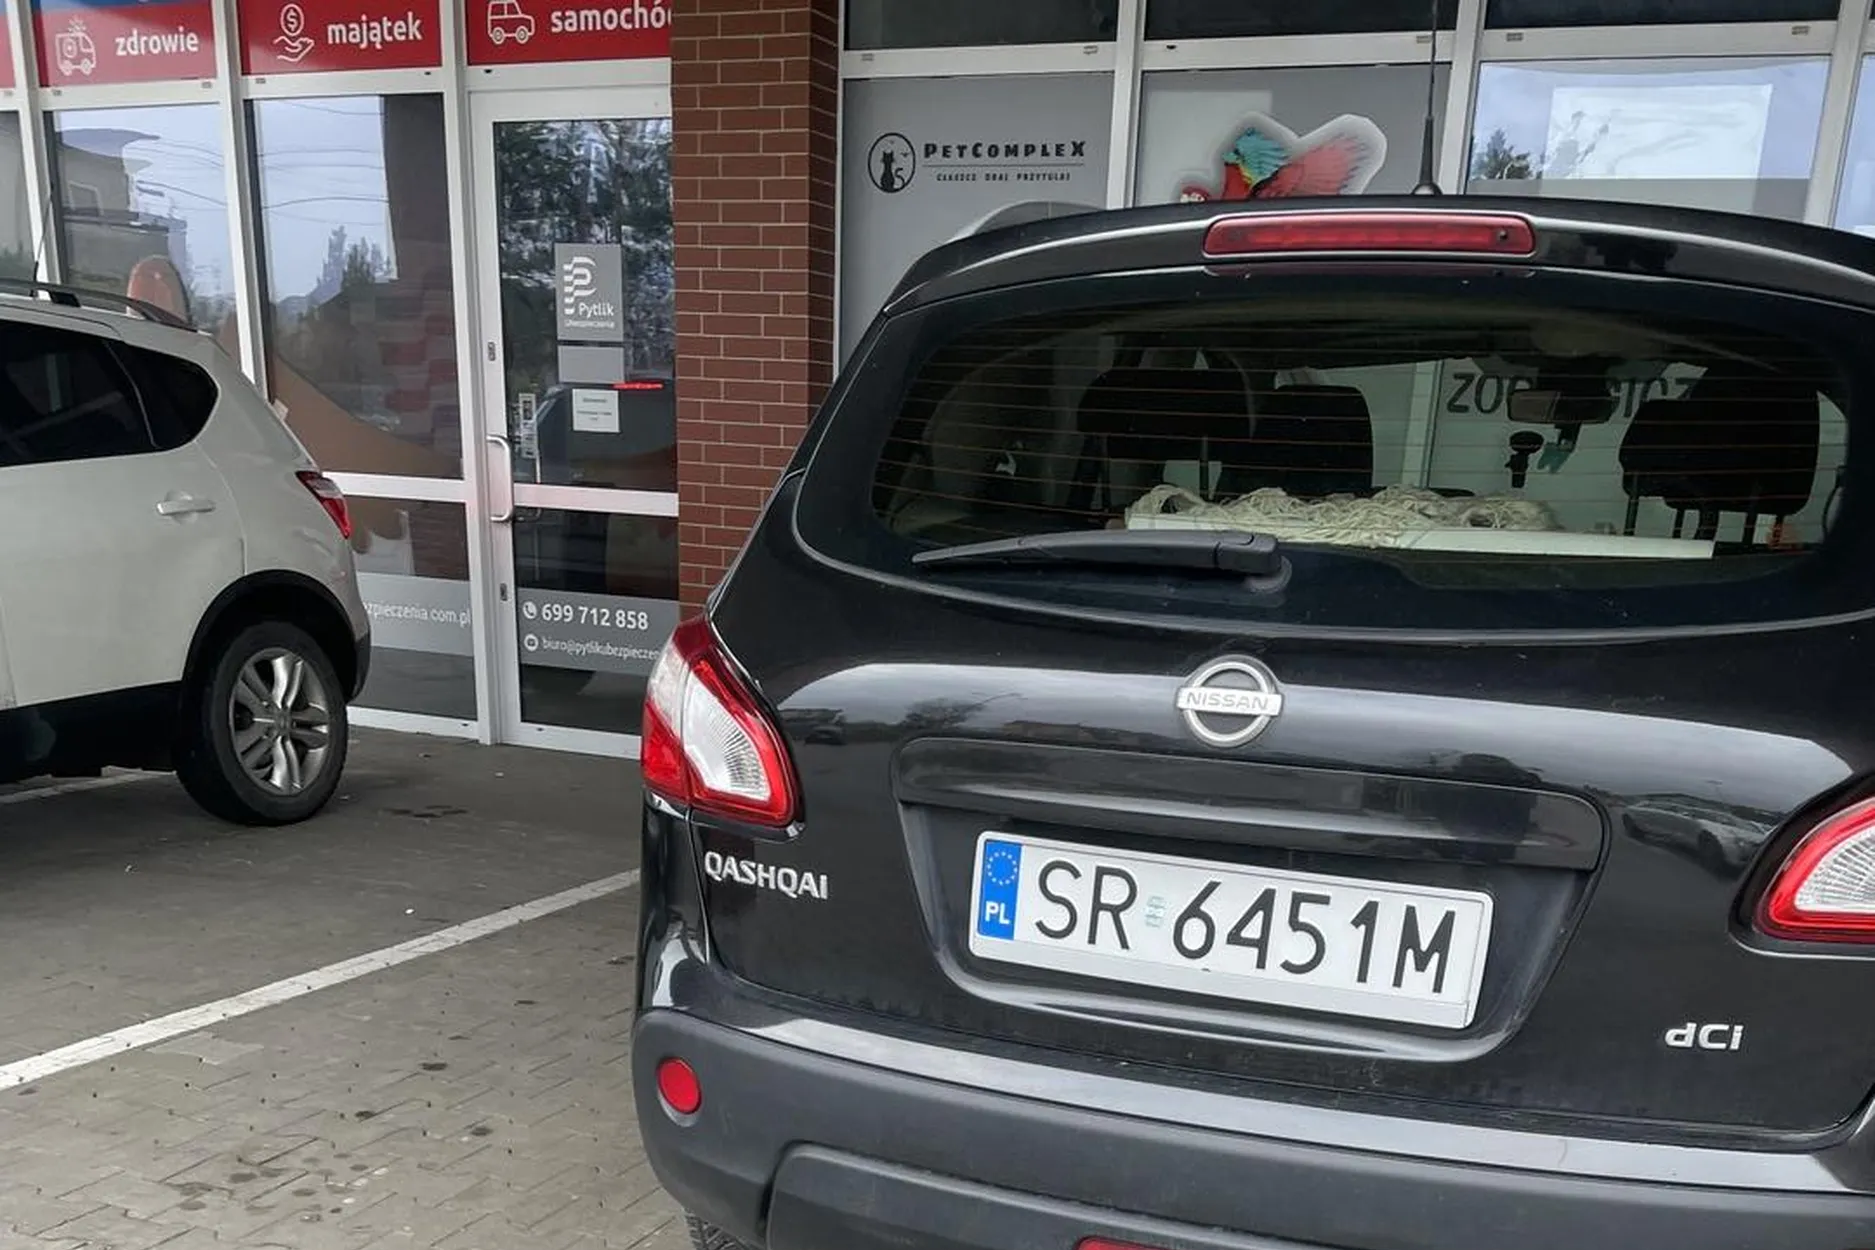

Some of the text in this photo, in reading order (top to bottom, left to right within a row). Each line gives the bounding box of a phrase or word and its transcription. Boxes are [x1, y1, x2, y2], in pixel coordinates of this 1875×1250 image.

[327, 11, 422, 49] majątek
[551, 0, 671, 33] samochó
[115, 25, 199, 56] zdrowie
[578, 302, 615, 319] Pytlik
[541, 603, 649, 630] 699 712 858
[1186, 691, 1269, 711] NISSAN
[704, 850, 828, 900] QASHQAI
[985, 900, 1012, 927] PL
[1034, 859, 1457, 995] SR 6451M
[1664, 1021, 1744, 1050] dCi
